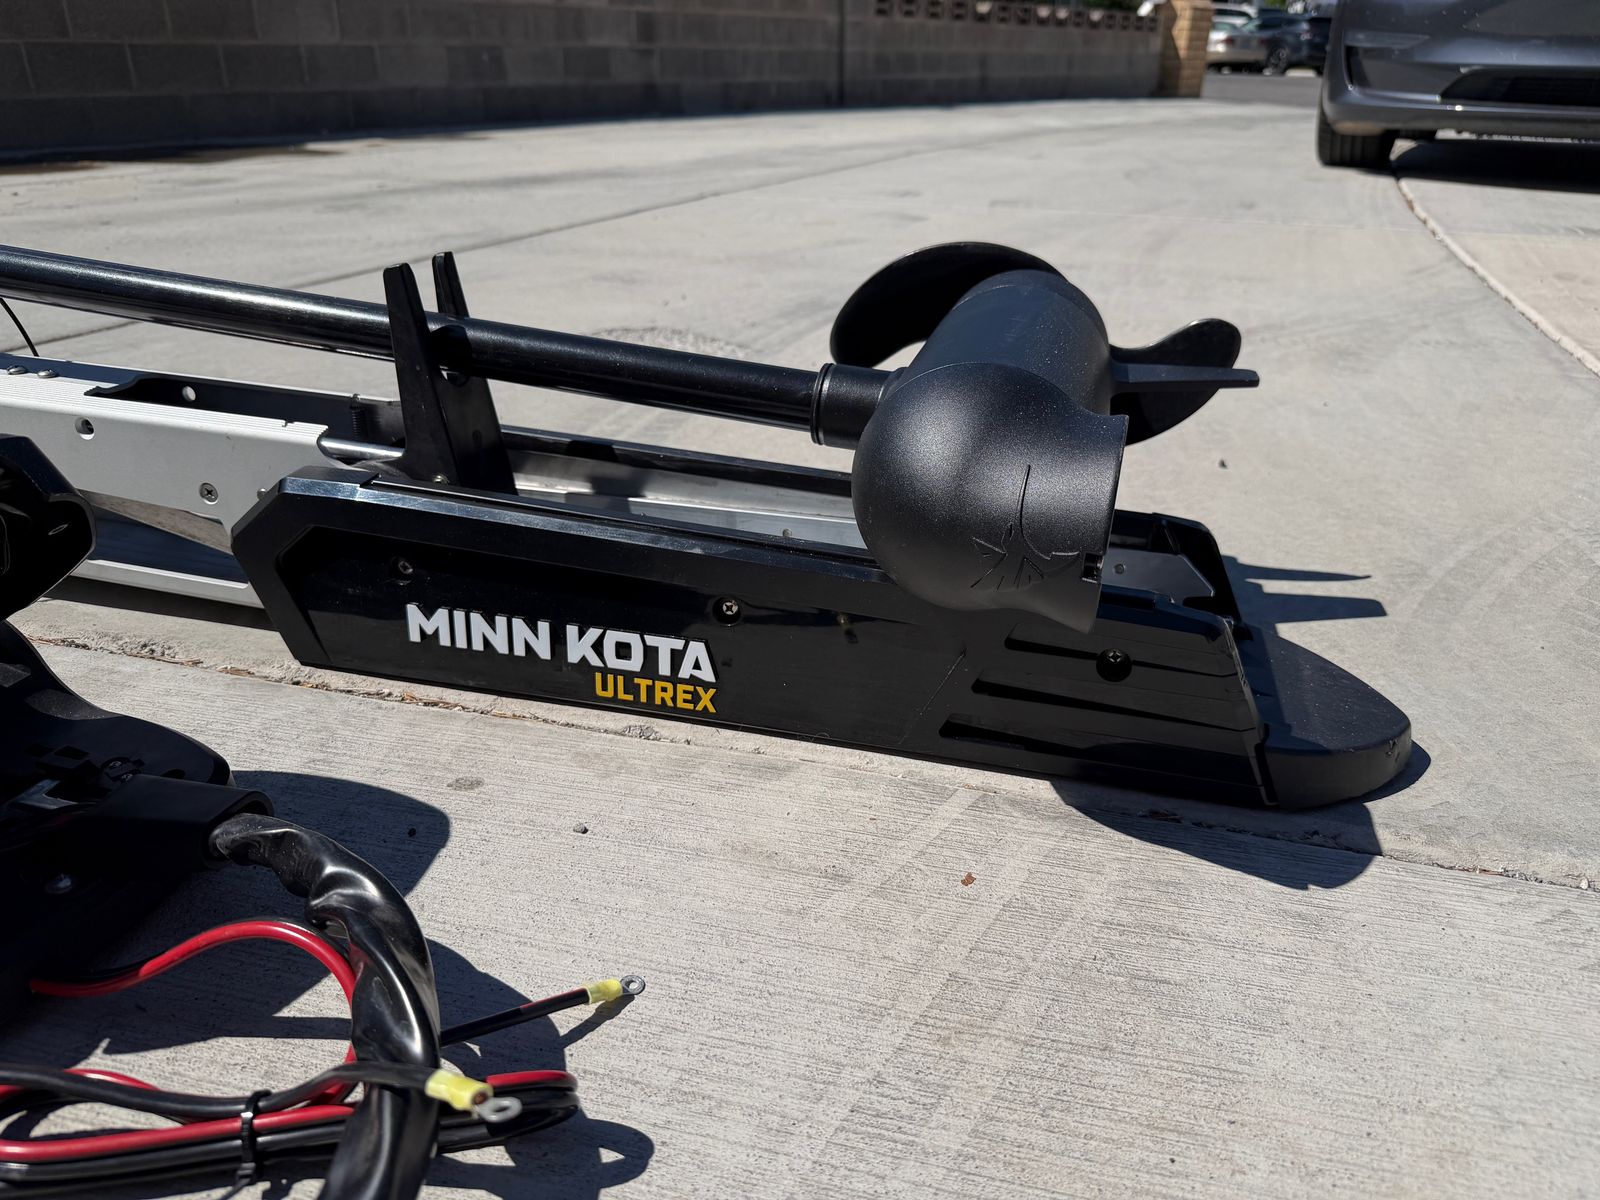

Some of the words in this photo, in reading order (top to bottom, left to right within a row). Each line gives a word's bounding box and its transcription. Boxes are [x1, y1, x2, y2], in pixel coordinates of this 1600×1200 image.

[406, 603, 551, 660] MINN
[566, 624, 717, 683] KOTA
[595, 672, 717, 713] ULTREX
